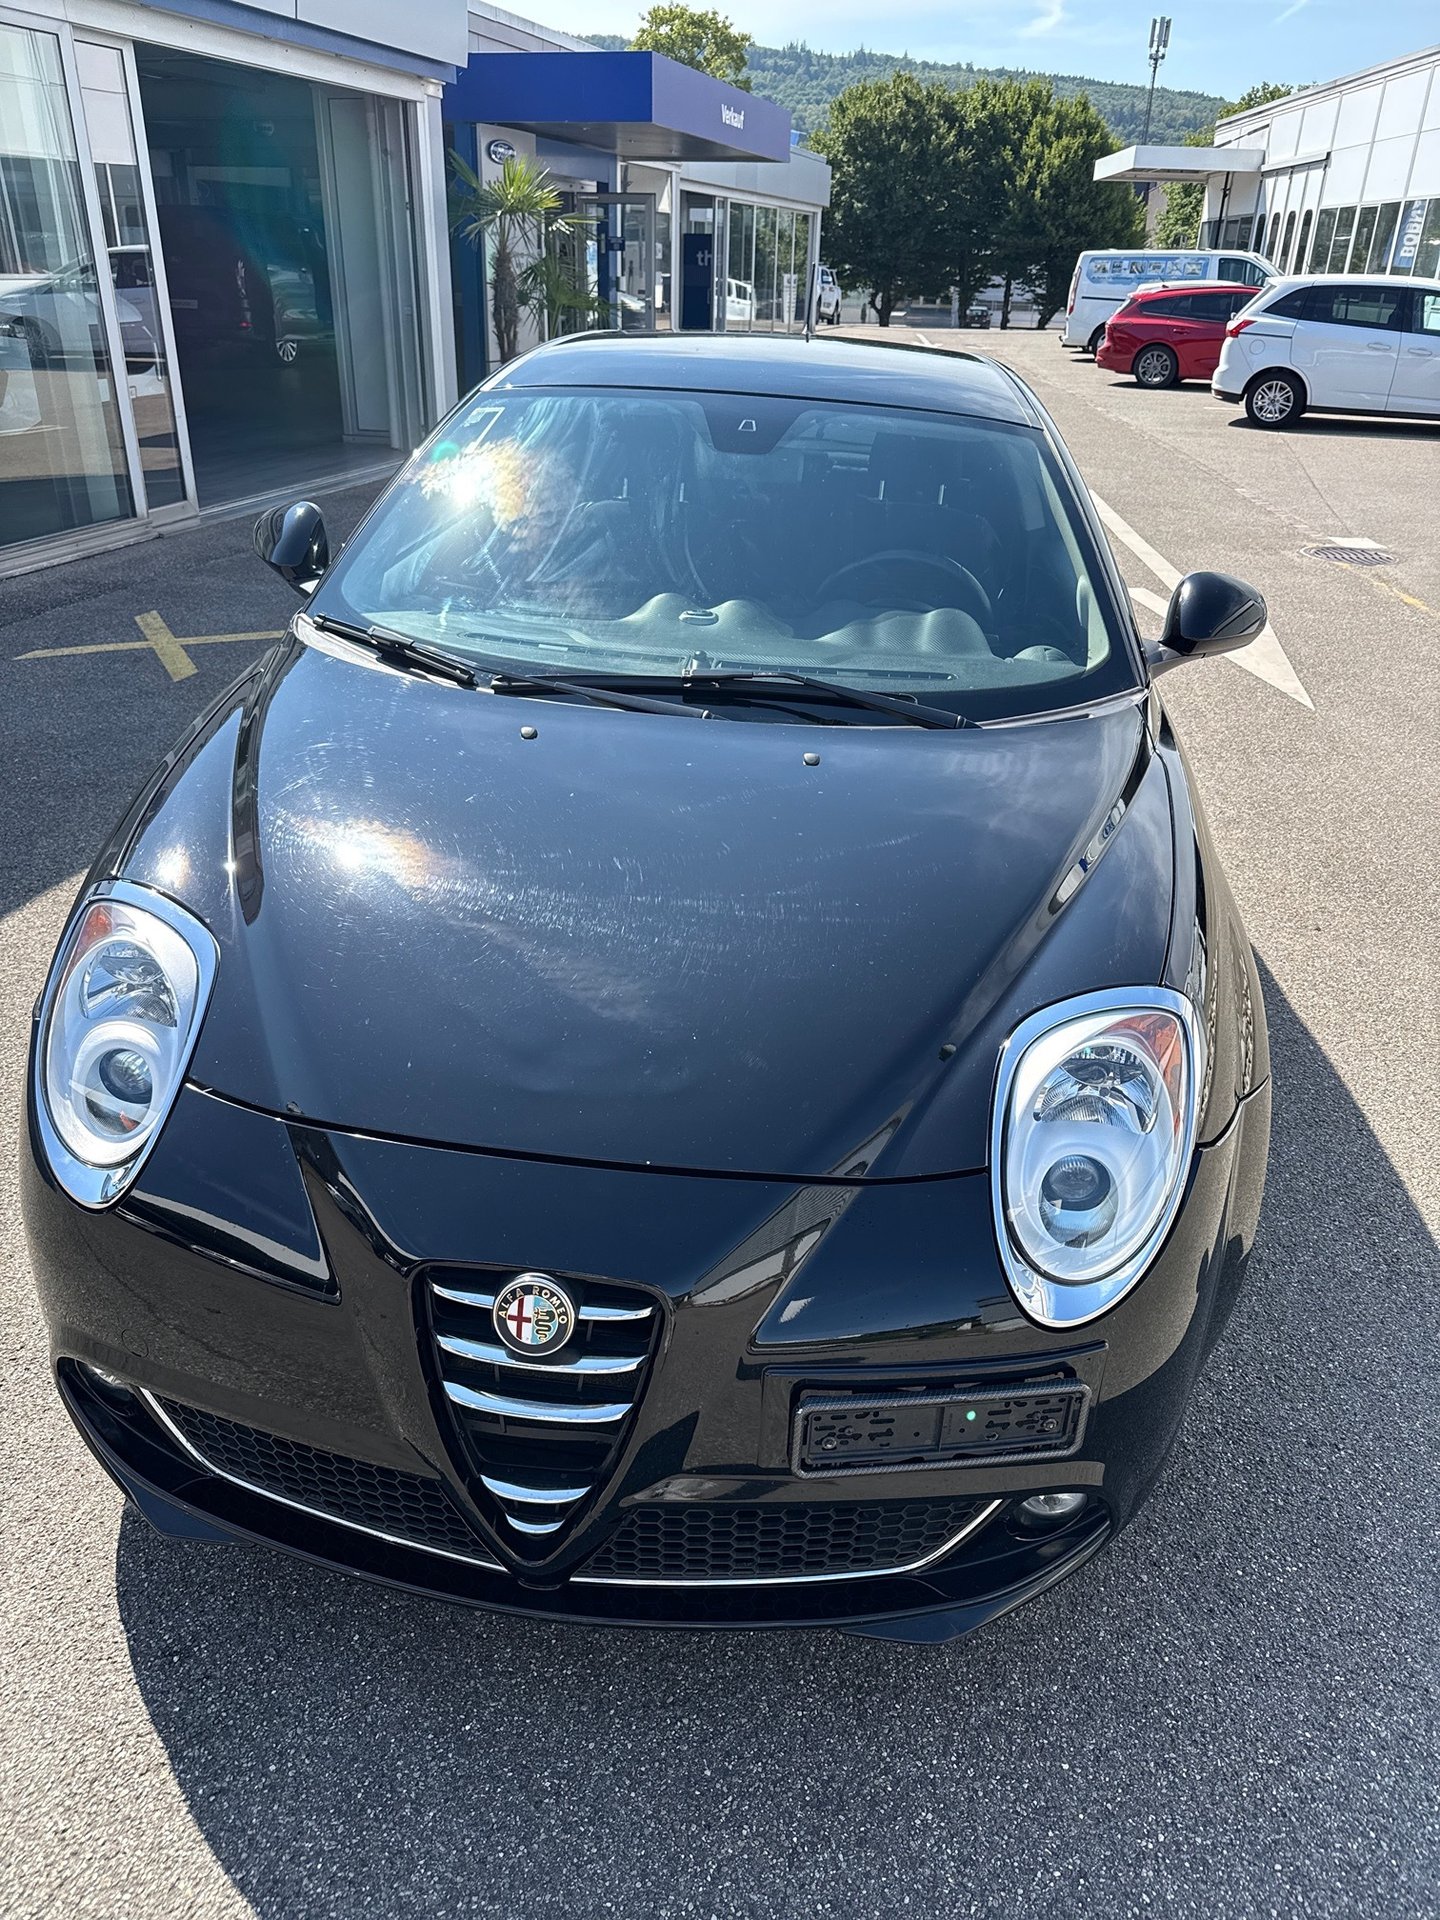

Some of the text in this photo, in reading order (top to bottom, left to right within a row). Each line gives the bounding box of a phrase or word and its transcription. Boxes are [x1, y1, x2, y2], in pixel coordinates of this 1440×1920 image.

[721, 103, 744, 130] Verkauf
[696, 249, 714, 267] th
[498, 1286, 568, 1324] ALFA ROMEO
